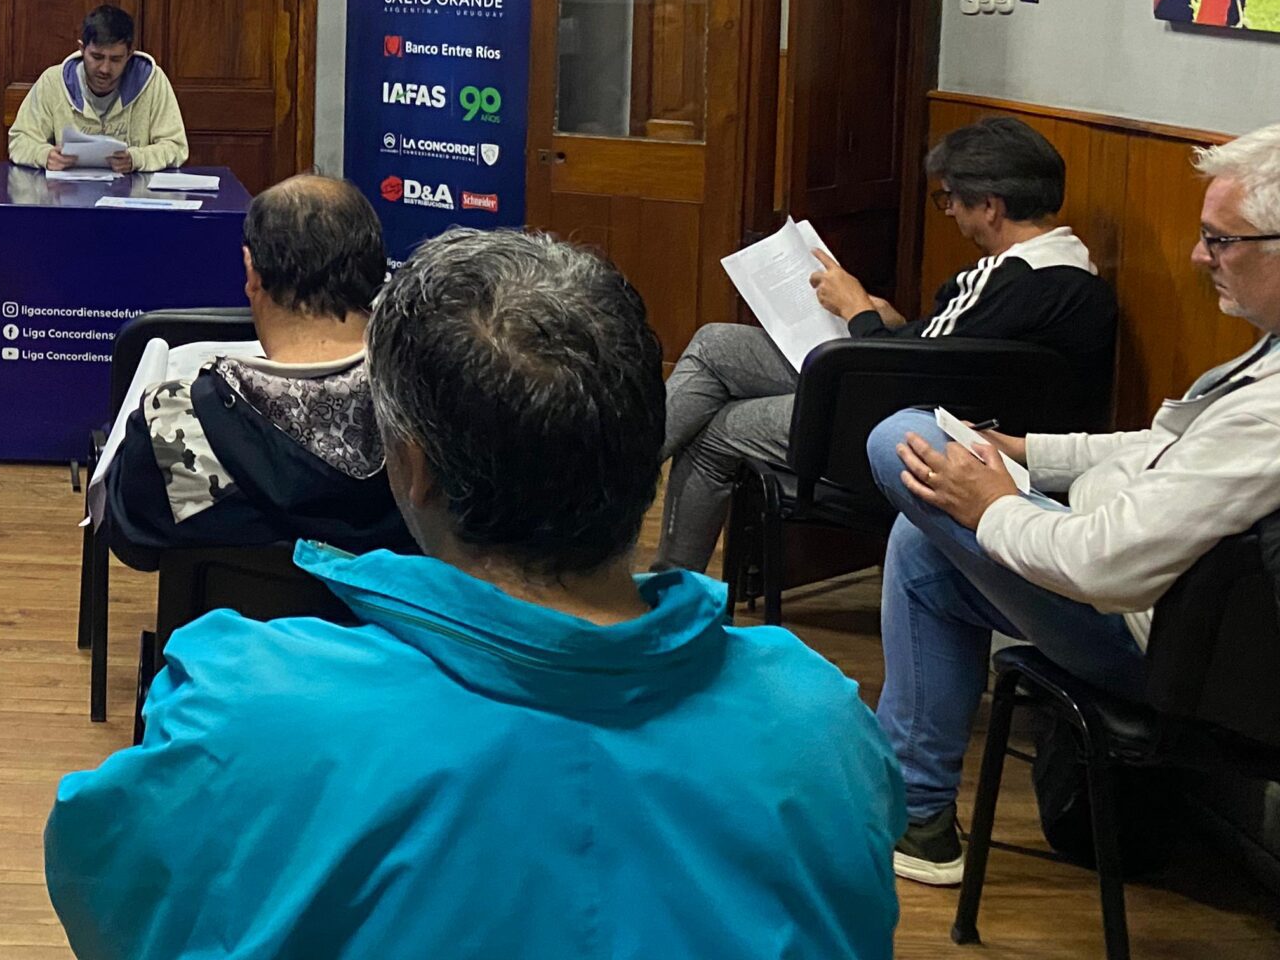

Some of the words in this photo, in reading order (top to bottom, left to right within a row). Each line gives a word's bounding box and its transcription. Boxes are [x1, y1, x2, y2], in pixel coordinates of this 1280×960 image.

[383, 6, 439, 15] ARGENTINA
[455, 9, 504, 19] URUGUAY
[405, 41, 438, 56] Banco
[441, 43, 473, 58] Entre
[475, 45, 501, 60] Ríos
[382, 81, 447, 109] IAFAS
[459, 85, 502, 122] 90
[402, 138, 417, 150] LA
[417, 139, 477, 157] CONCORDE
[403, 179, 454, 204] D&A
[403, 197, 455, 210] DISTRIBUCIONES
[22, 327, 46, 340] Liga
[48, 328, 116, 341] Concordiens
[22, 350, 44, 362] Liga
